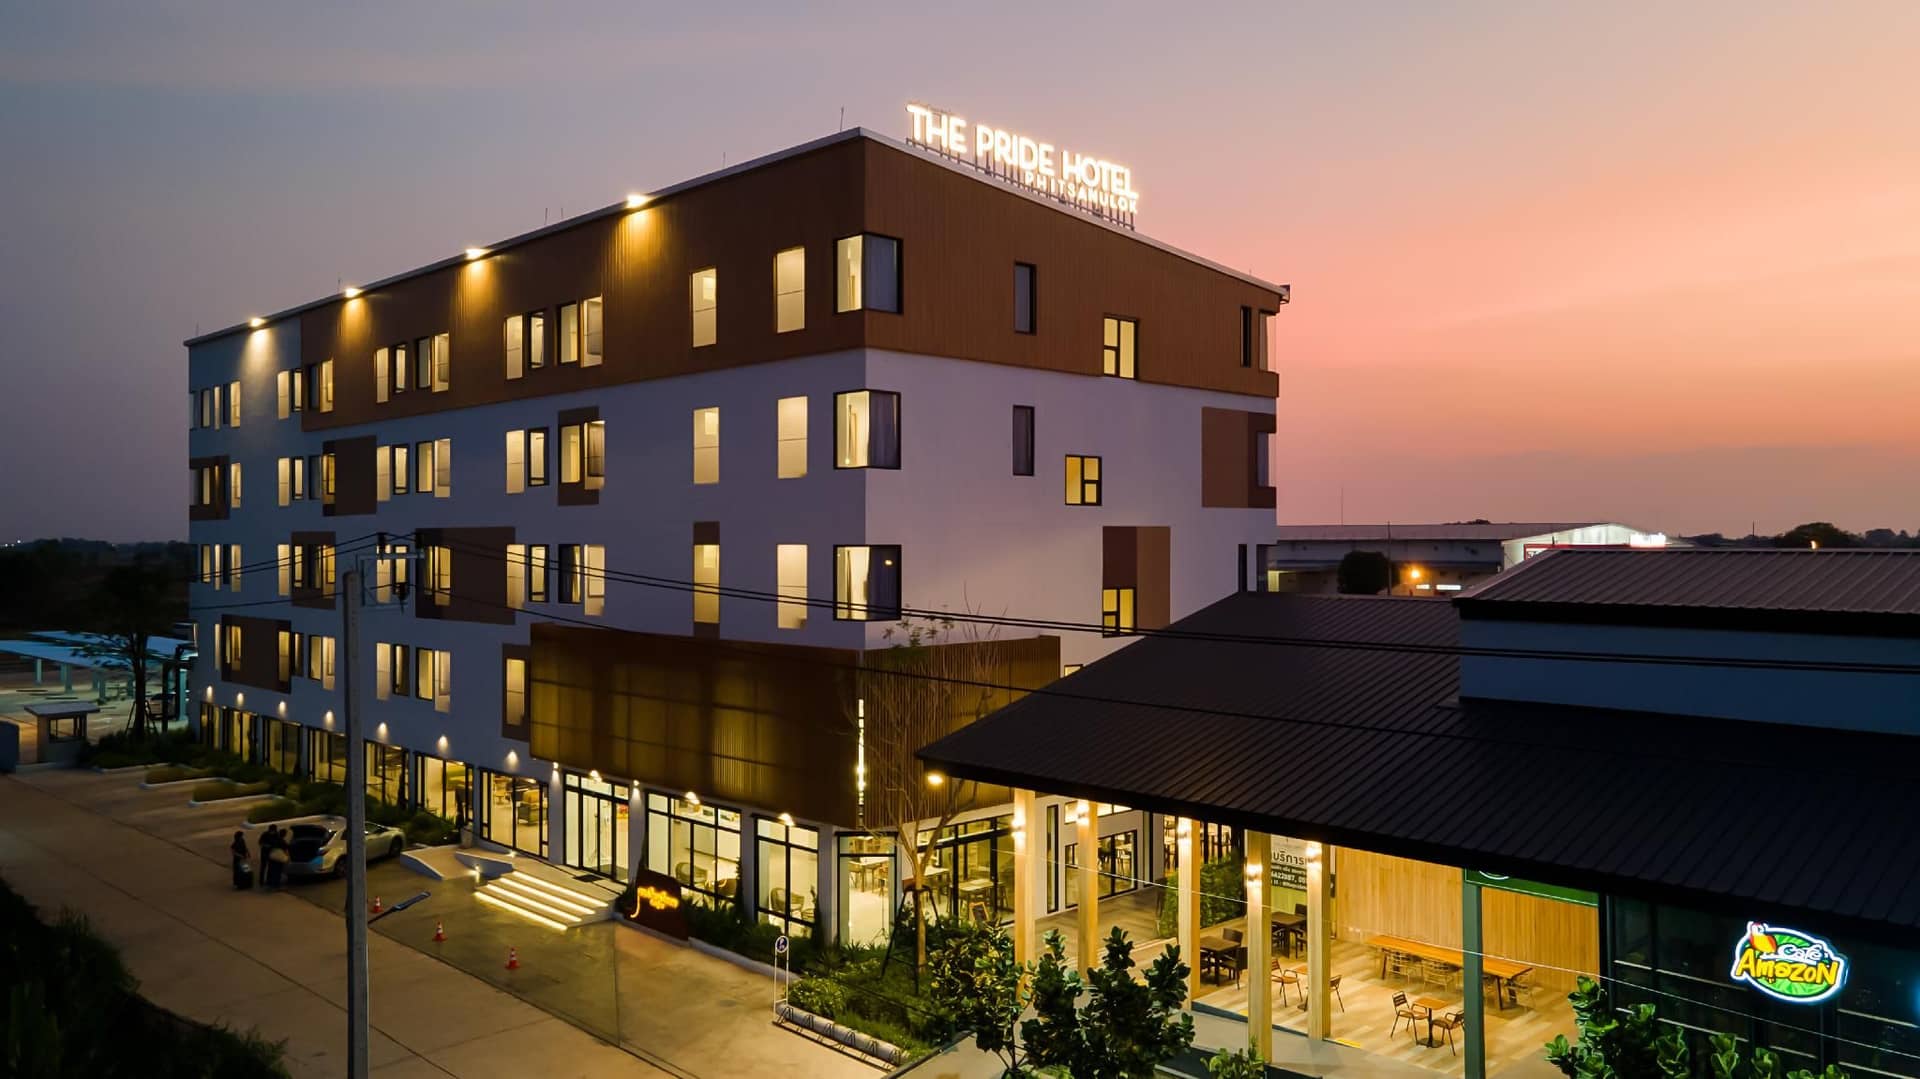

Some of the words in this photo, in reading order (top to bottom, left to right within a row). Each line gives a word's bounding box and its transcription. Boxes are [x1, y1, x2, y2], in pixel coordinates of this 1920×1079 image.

[906, 104, 968, 154] THE
[976, 124, 1055, 177] PRIDE
[1062, 149, 1139, 198] HOTEL
[1024, 170, 1138, 214] PHITSANULOK
[1273, 850, 1306, 866] บริการ
